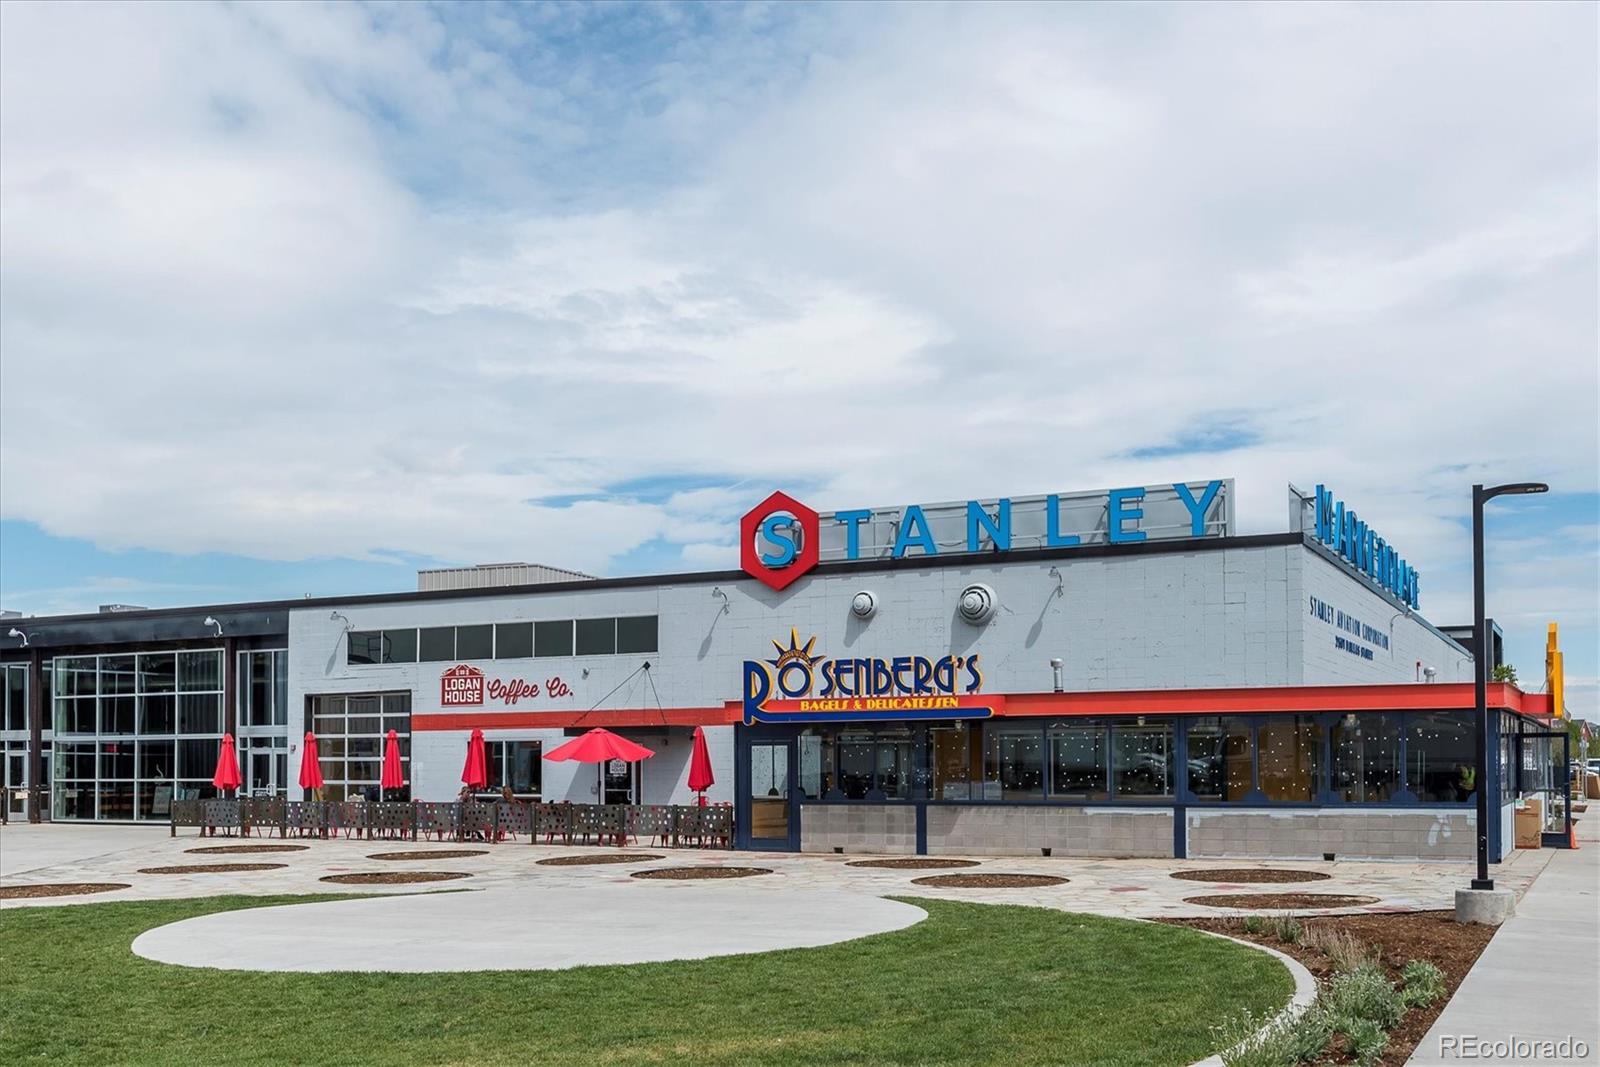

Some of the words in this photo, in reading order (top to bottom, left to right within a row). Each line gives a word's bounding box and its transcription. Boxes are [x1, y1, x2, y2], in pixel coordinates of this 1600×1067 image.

[762, 480, 1224, 566] STANLEY
[1310, 595, 1334, 624] STANLEY
[1337, 609, 1361, 637] AVIATION
[1362, 623, 1389, 650] CORPORATION
[444, 678, 481, 691] LOGAN
[444, 691, 481, 703] HOUSE
[487, 678, 540, 705] Coffee
[546, 677, 574, 698] Co.
[742, 653, 984, 726] ROSENBERG'S
[800, 700, 849, 712] BAGELS
[853, 701, 862, 710] &
[866, 697, 959, 710] DELICATESSEN
